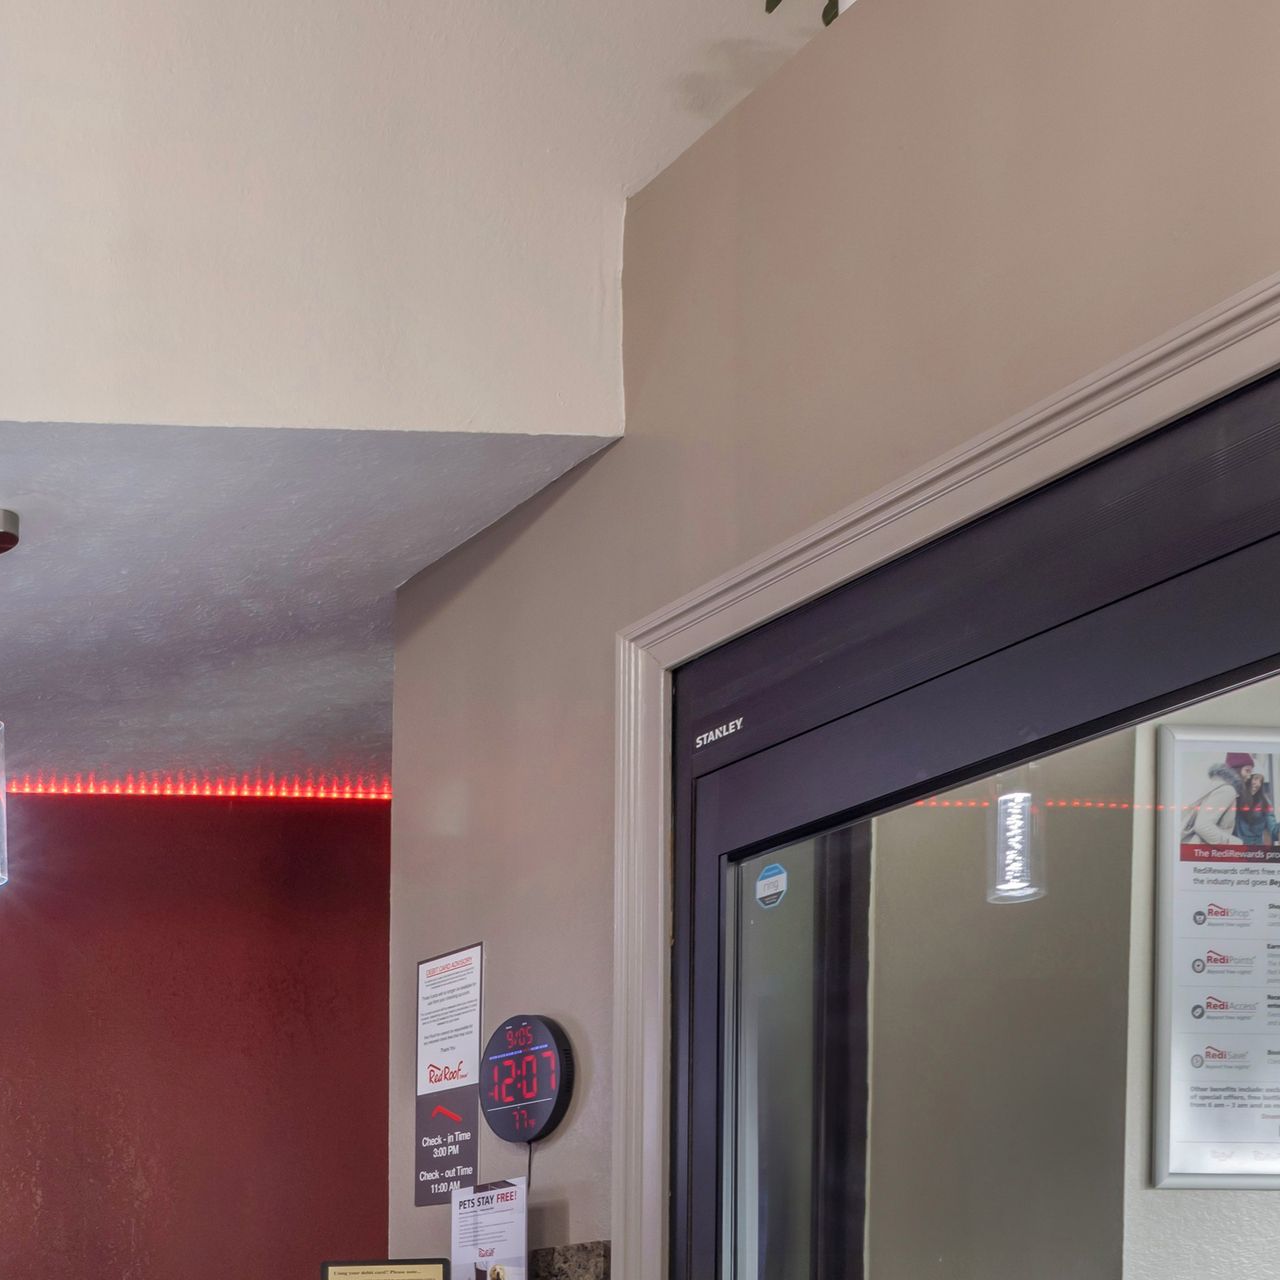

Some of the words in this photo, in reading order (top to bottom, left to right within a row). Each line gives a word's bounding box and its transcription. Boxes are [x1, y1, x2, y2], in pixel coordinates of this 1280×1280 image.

[696, 717, 744, 748] STANLEY
[1194, 848, 1210, 857] The
[1211, 849, 1264, 858] RediRewards
[493, 1050, 556, 1103] 12:07
[422, 1136, 442, 1147] Check
[448, 1133, 454, 1143] in
[455, 1131, 471, 1142] Time
[433, 1147, 447, 1158] 3:00
[448, 1144, 459, 1156] PM
[420, 1170, 439, 1181] Check
[445, 1167, 456, 1178] out
[456, 1165, 473, 1176] Time
[430, 1182, 448, 1194] 11:00
[449, 1180, 460, 1191] AM
[459, 1198, 475, 1210] PETS
[477, 1194, 494, 1207] STAY
[496, 1190, 517, 1203] FREE!
